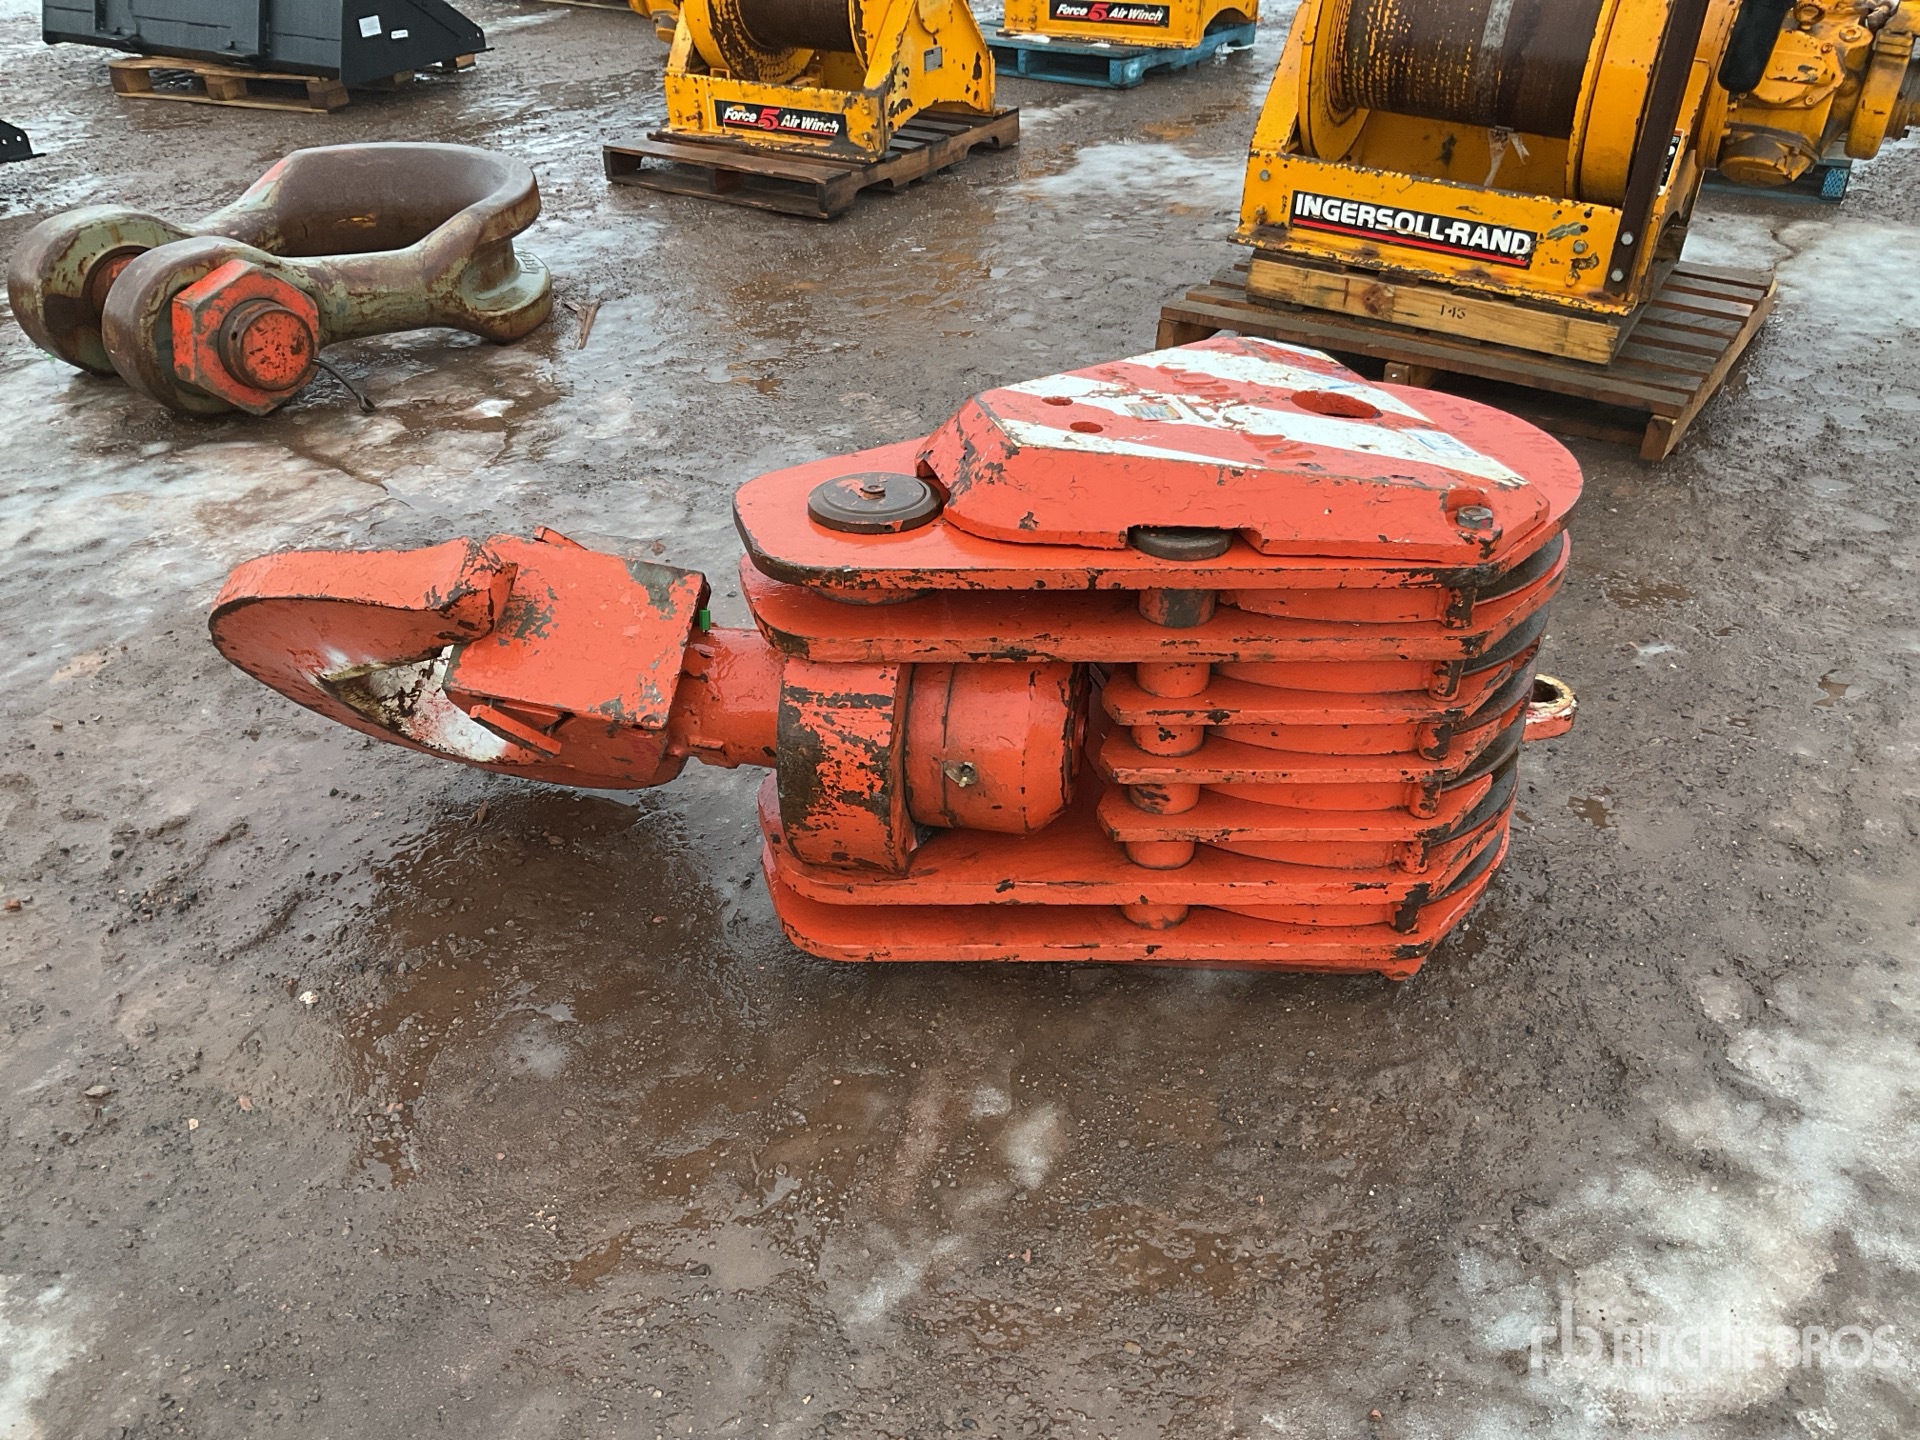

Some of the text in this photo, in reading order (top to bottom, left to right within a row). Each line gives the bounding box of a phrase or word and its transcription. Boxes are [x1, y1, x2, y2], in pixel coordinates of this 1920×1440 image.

[1056, 3, 1163, 21] Force 5 Air Winch
[724, 107, 840, 133] Force 5 Air Winch
[1294, 193, 1532, 255] INGERSOLL-RAND
